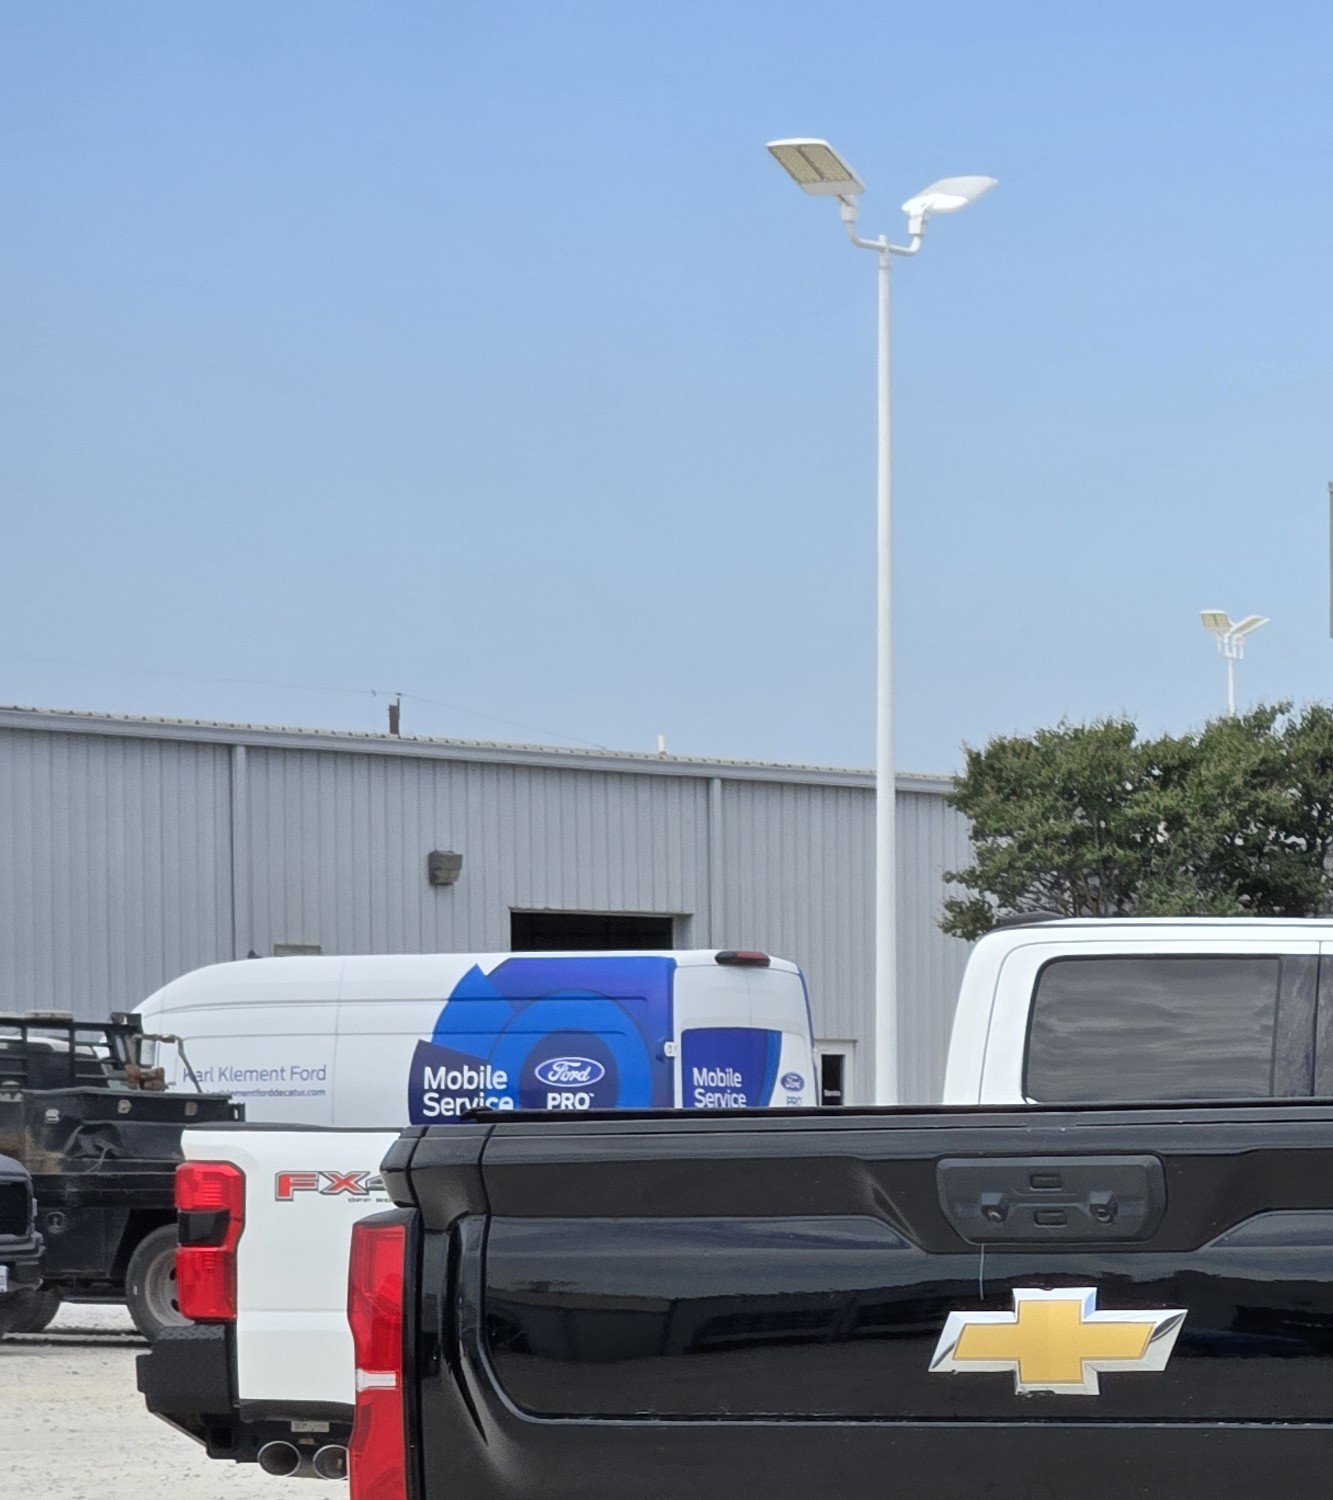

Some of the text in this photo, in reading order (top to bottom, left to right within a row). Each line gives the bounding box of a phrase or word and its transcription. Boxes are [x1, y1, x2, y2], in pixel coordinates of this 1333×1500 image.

[218, 1066, 286, 1083] Klement
[290, 1065, 327, 1082] Ford
[423, 1064, 508, 1091] Mobile
[547, 1060, 592, 1083] Ford
[692, 1067, 743, 1088] Mobile
[422, 1091, 514, 1117] Service
[694, 1089, 747, 1107] Service
